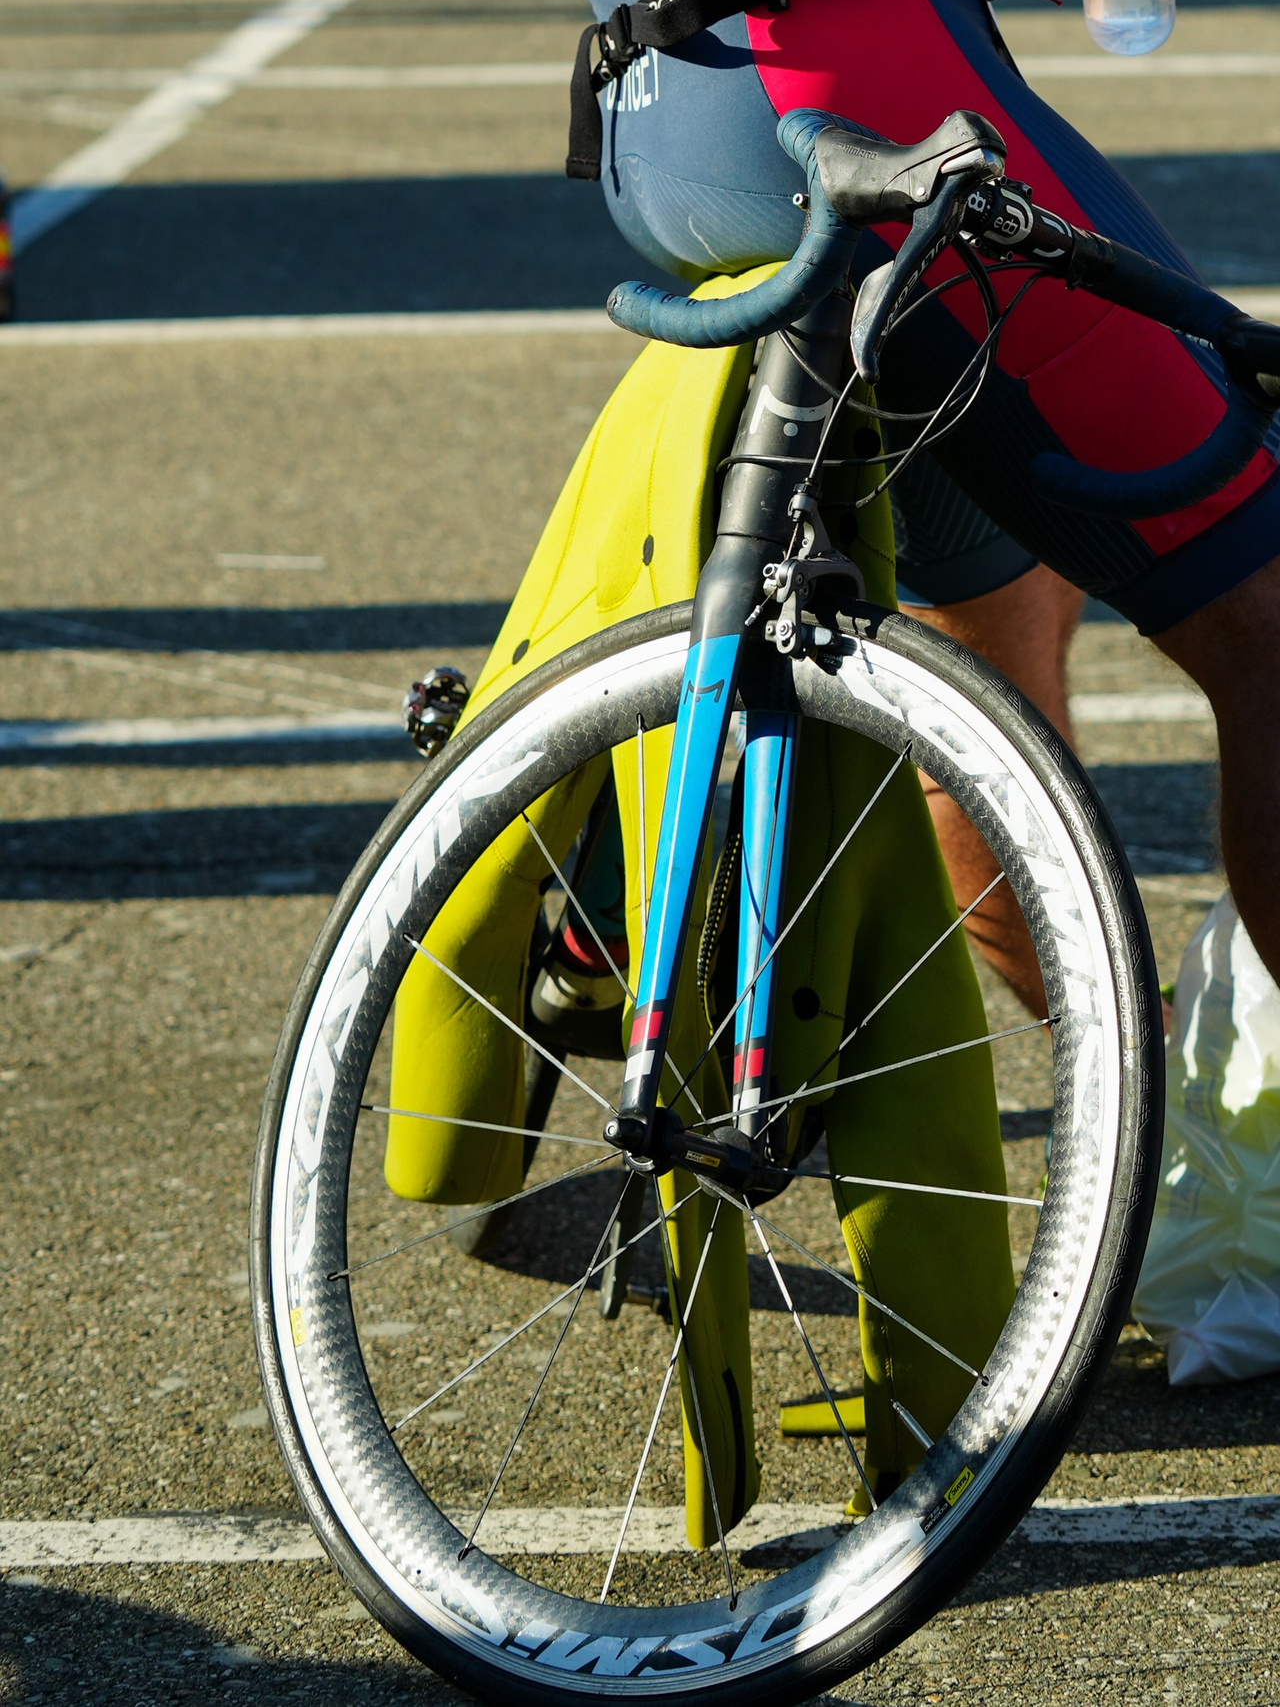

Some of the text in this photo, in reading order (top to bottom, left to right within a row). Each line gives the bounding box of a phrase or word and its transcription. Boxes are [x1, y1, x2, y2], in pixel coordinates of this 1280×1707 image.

[1058, 794, 1133, 1034] GRAND PRIX 4000
[950, 1474, 968, 1497] MAVIC
